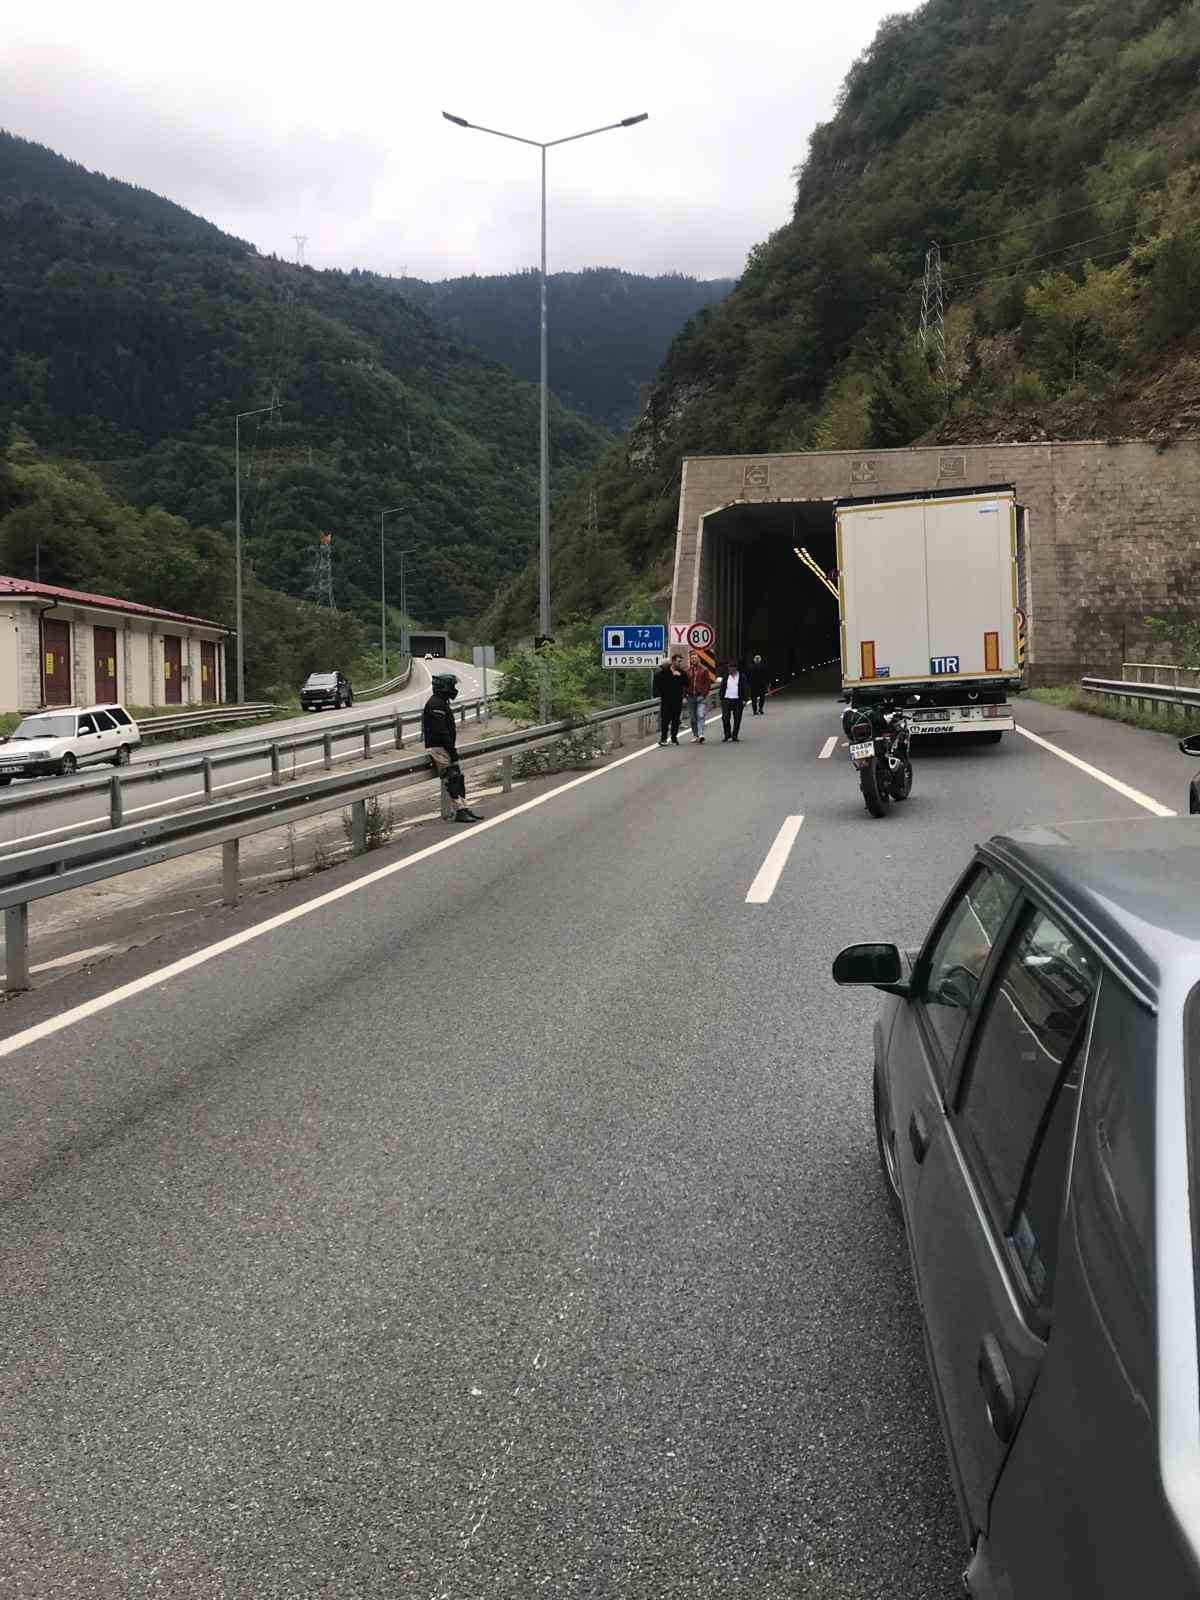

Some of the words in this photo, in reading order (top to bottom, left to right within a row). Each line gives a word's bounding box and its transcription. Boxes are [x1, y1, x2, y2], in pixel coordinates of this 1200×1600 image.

[637, 629, 650, 638] T2
[674, 627, 686, 643] Y
[692, 630, 709, 643] 80
[932, 657, 958, 673] TIR
[920, 725, 954, 733] KRONE
